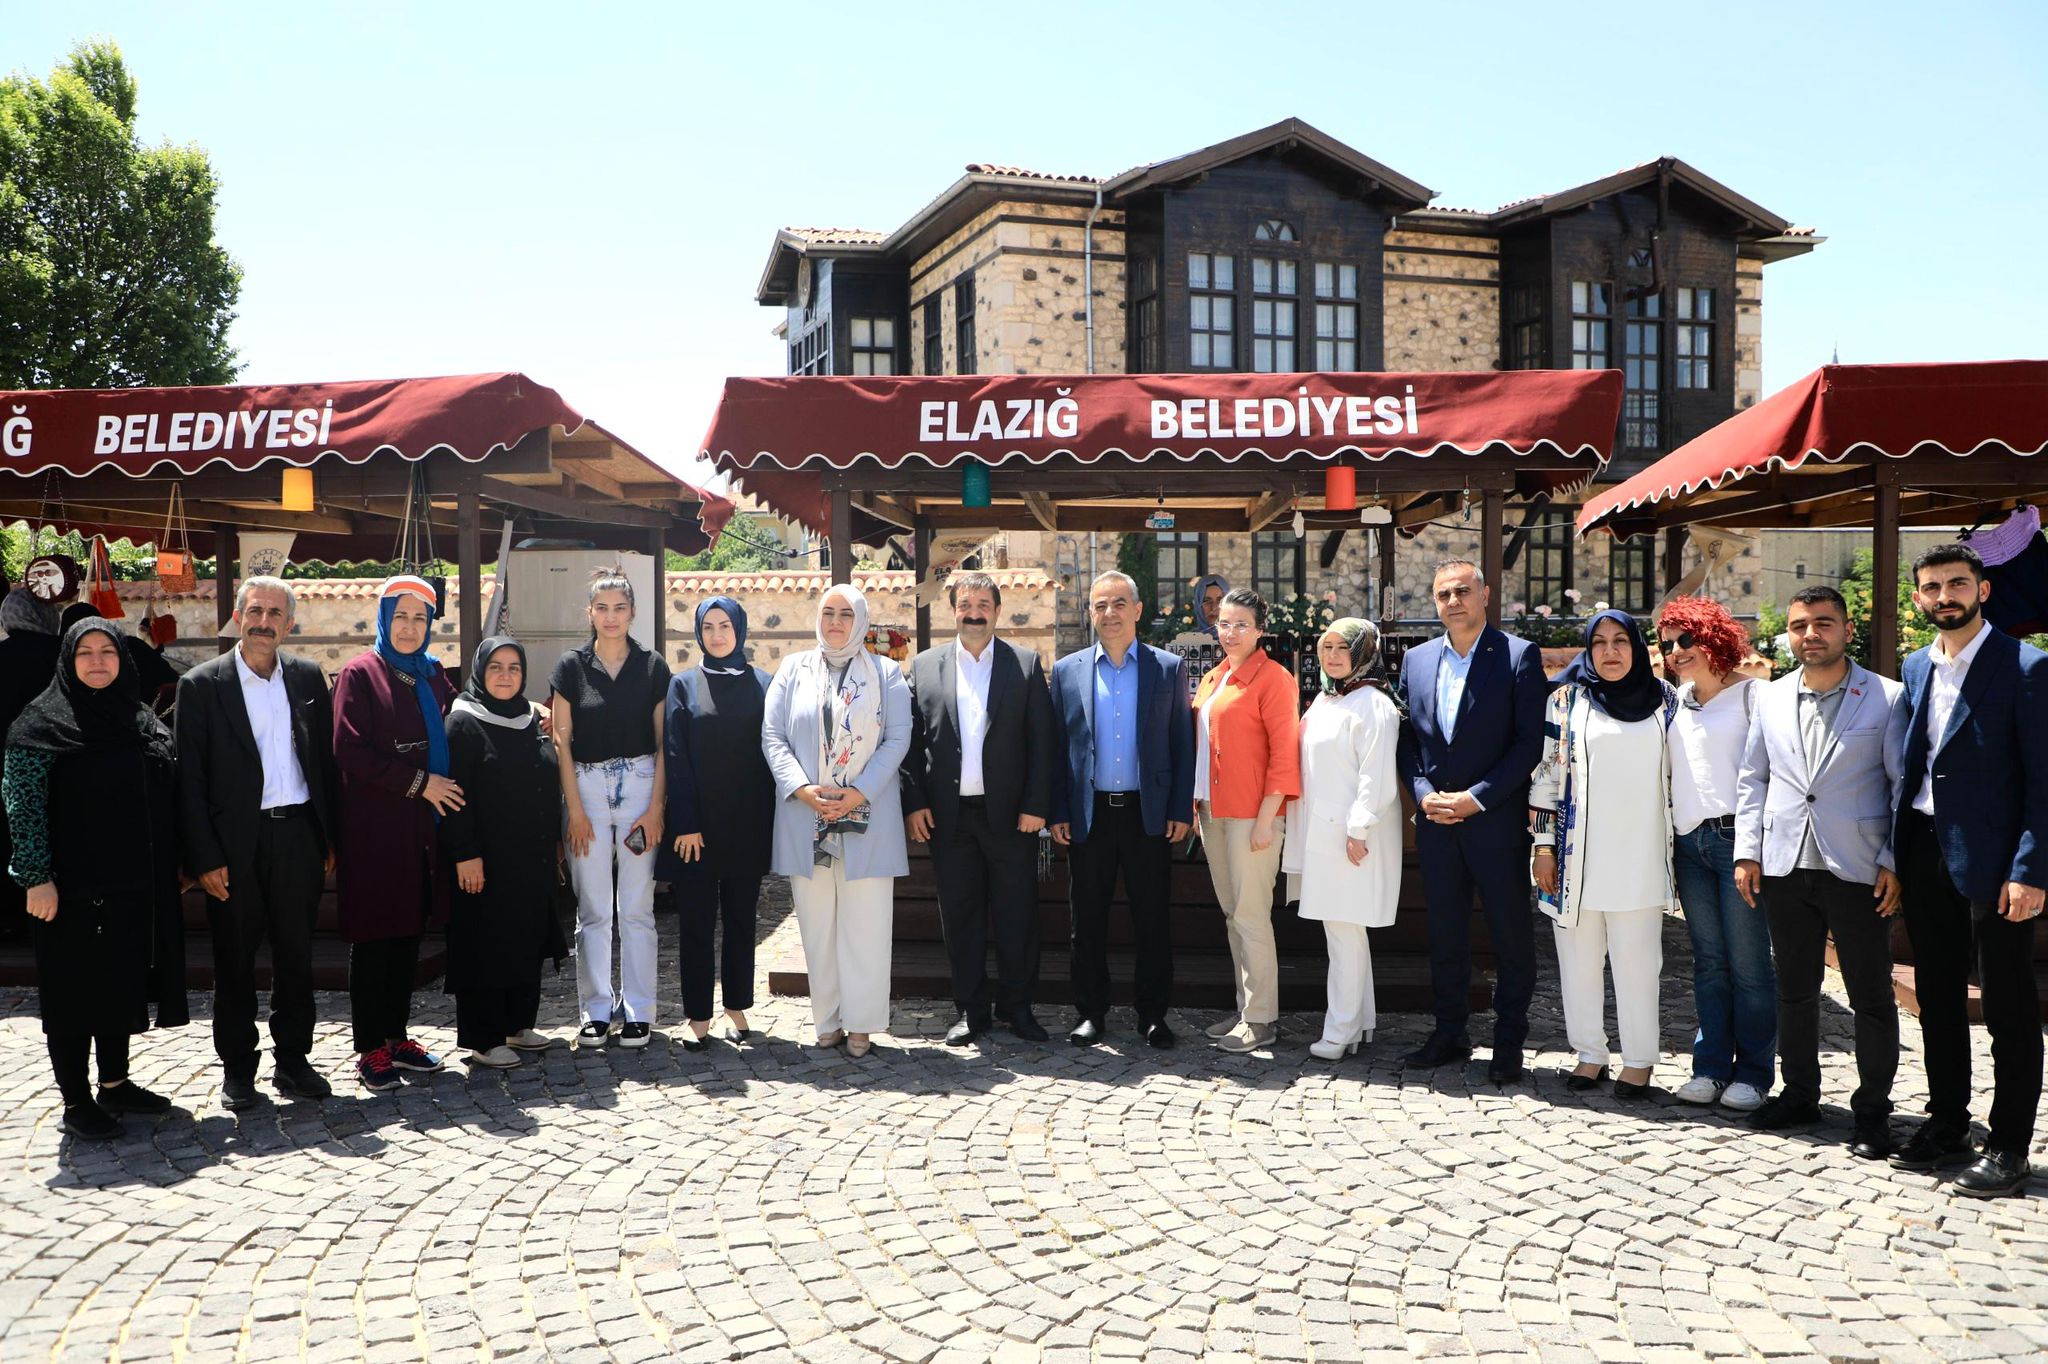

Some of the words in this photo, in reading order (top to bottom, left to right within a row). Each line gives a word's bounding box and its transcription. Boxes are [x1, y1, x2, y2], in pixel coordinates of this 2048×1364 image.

[94, 399, 334, 455] BELEDIYESİ
[919, 387, 1080, 442] ELAZIĞ
[1150, 385, 1419, 439] BELEDİYESİ
